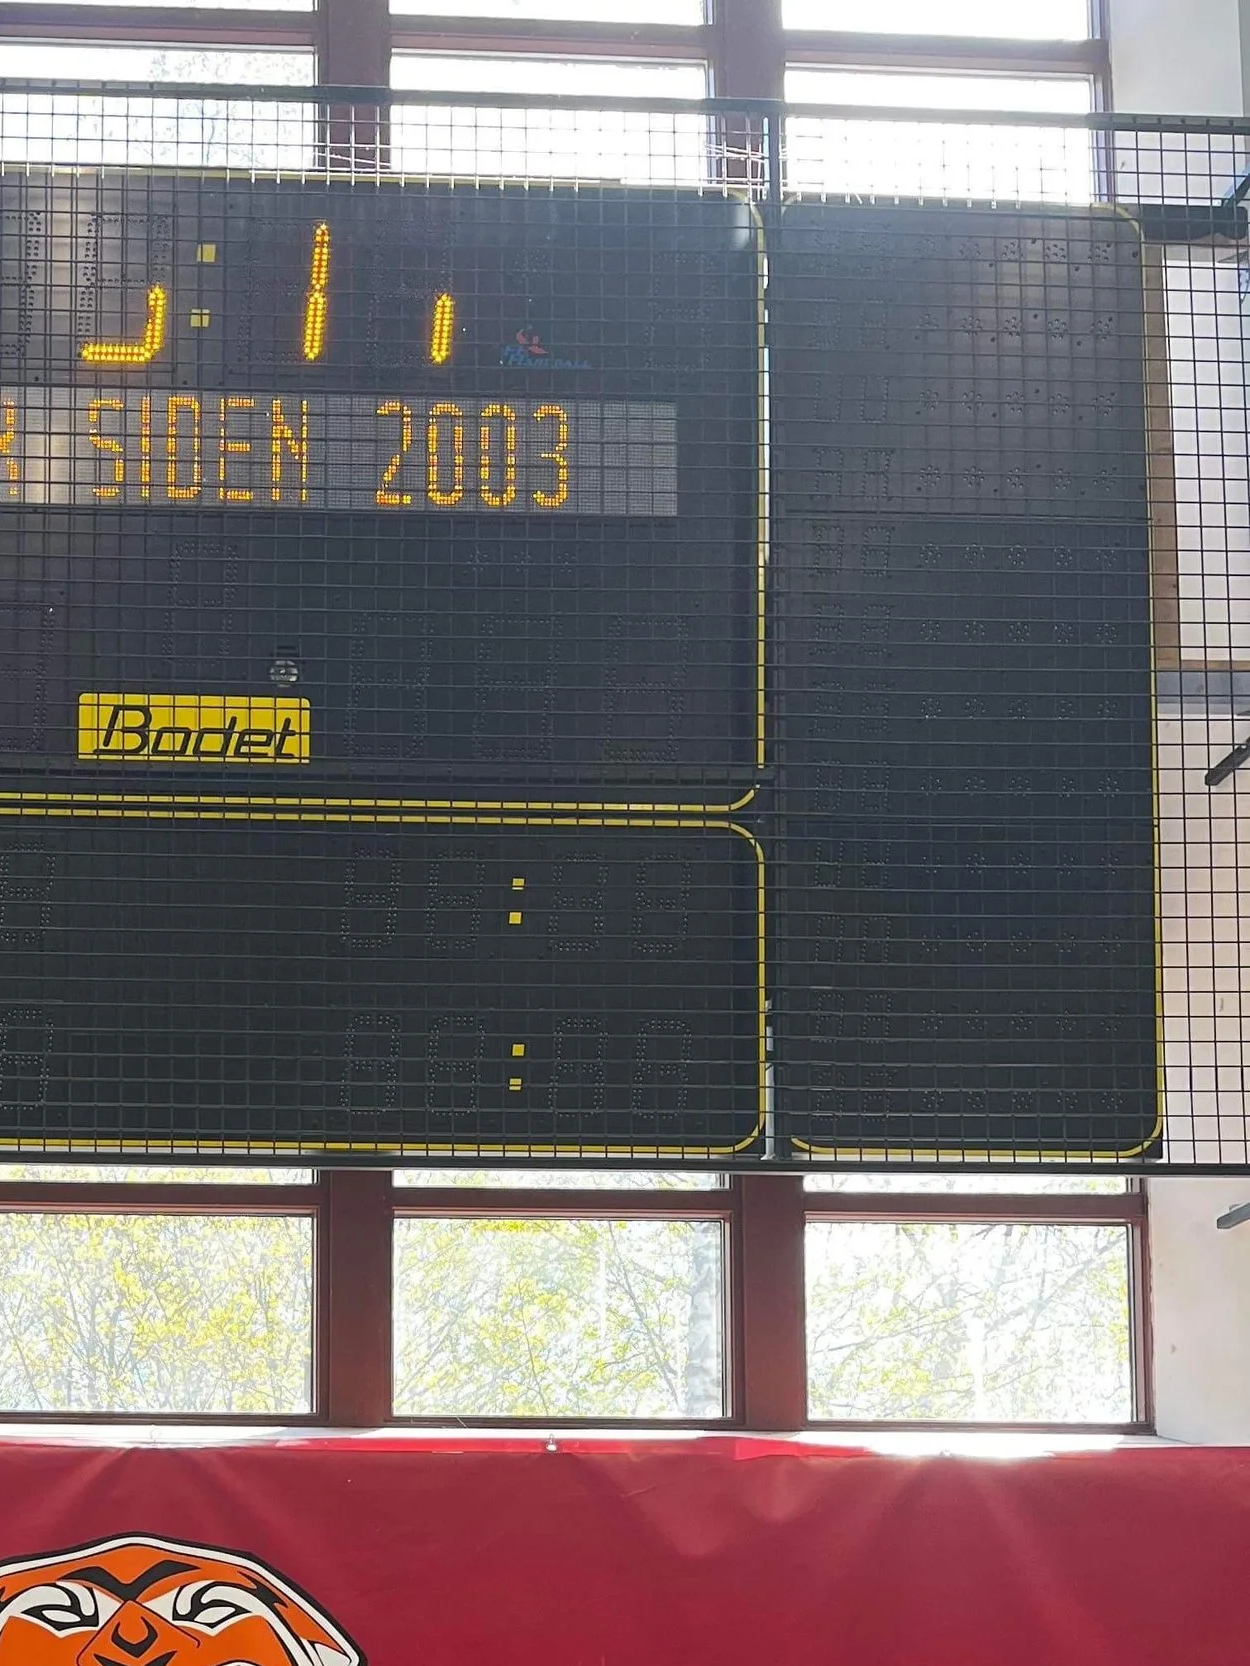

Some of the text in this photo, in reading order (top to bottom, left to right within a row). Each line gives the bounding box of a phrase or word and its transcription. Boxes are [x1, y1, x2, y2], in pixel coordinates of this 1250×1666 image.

[88, 396, 308, 500] SIDEN
[376, 401, 568, 507] 2003
[92, 705, 297, 759] Bodet
